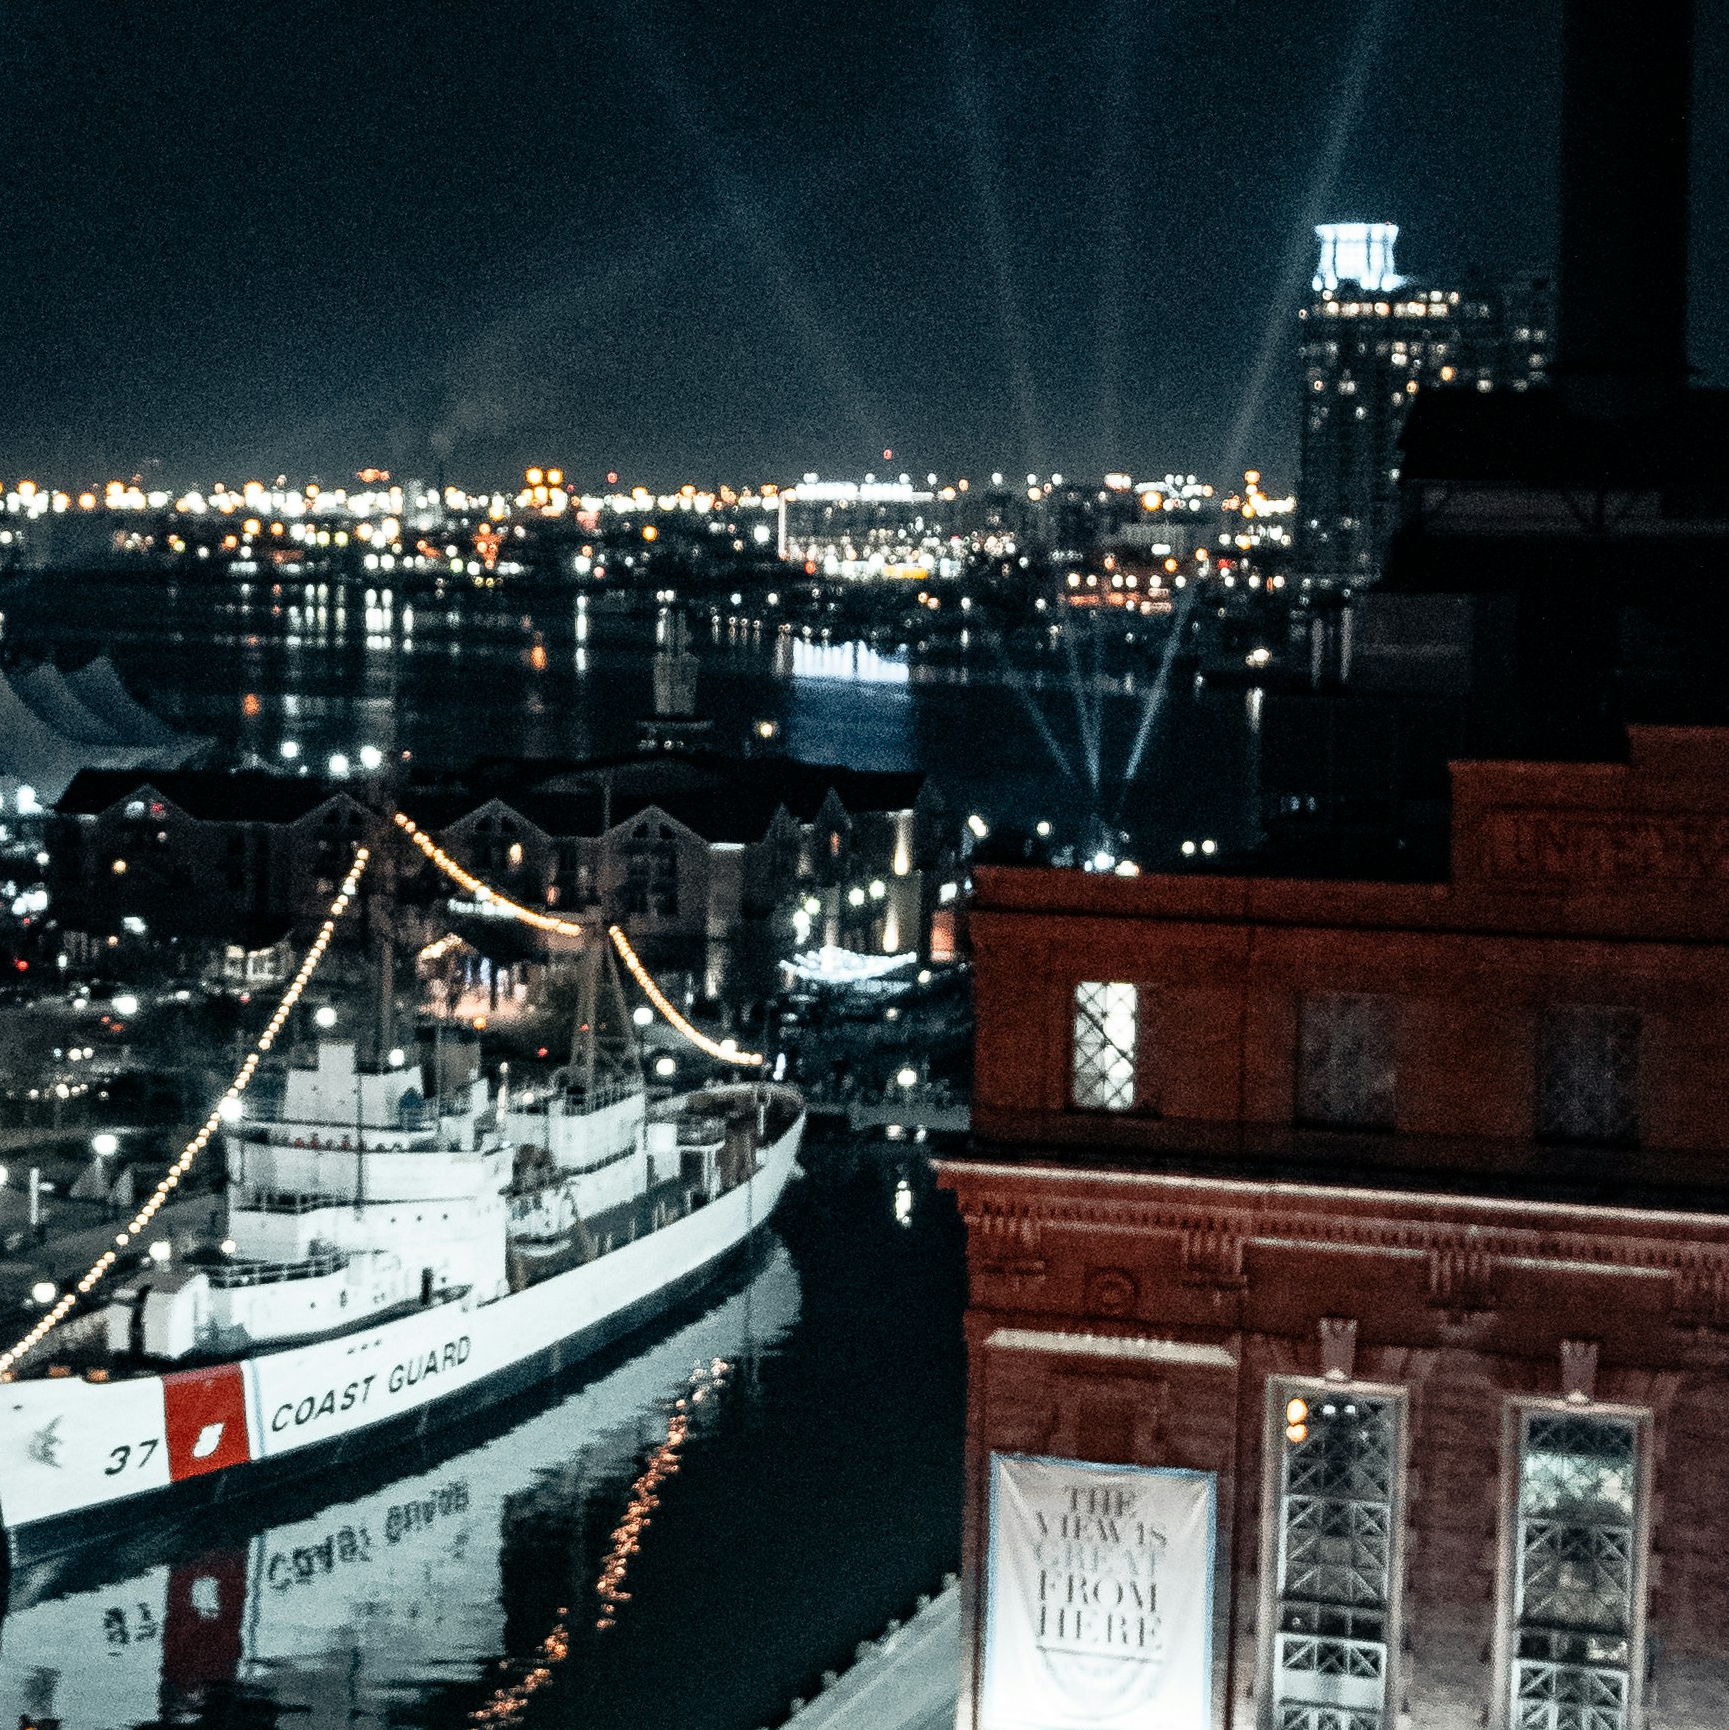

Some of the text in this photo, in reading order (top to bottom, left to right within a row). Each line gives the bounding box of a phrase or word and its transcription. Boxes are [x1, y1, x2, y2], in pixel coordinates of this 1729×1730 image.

[271, 1335, 471, 1433] COAST GUARD
[104, 1438, 160, 1476] 37
[1062, 1485, 1139, 1519] THE
[1034, 1510, 1168, 1549] VIEW IS
[1036, 1569, 1159, 1614] FROM
[1036, 1604, 1164, 1650] HERE
